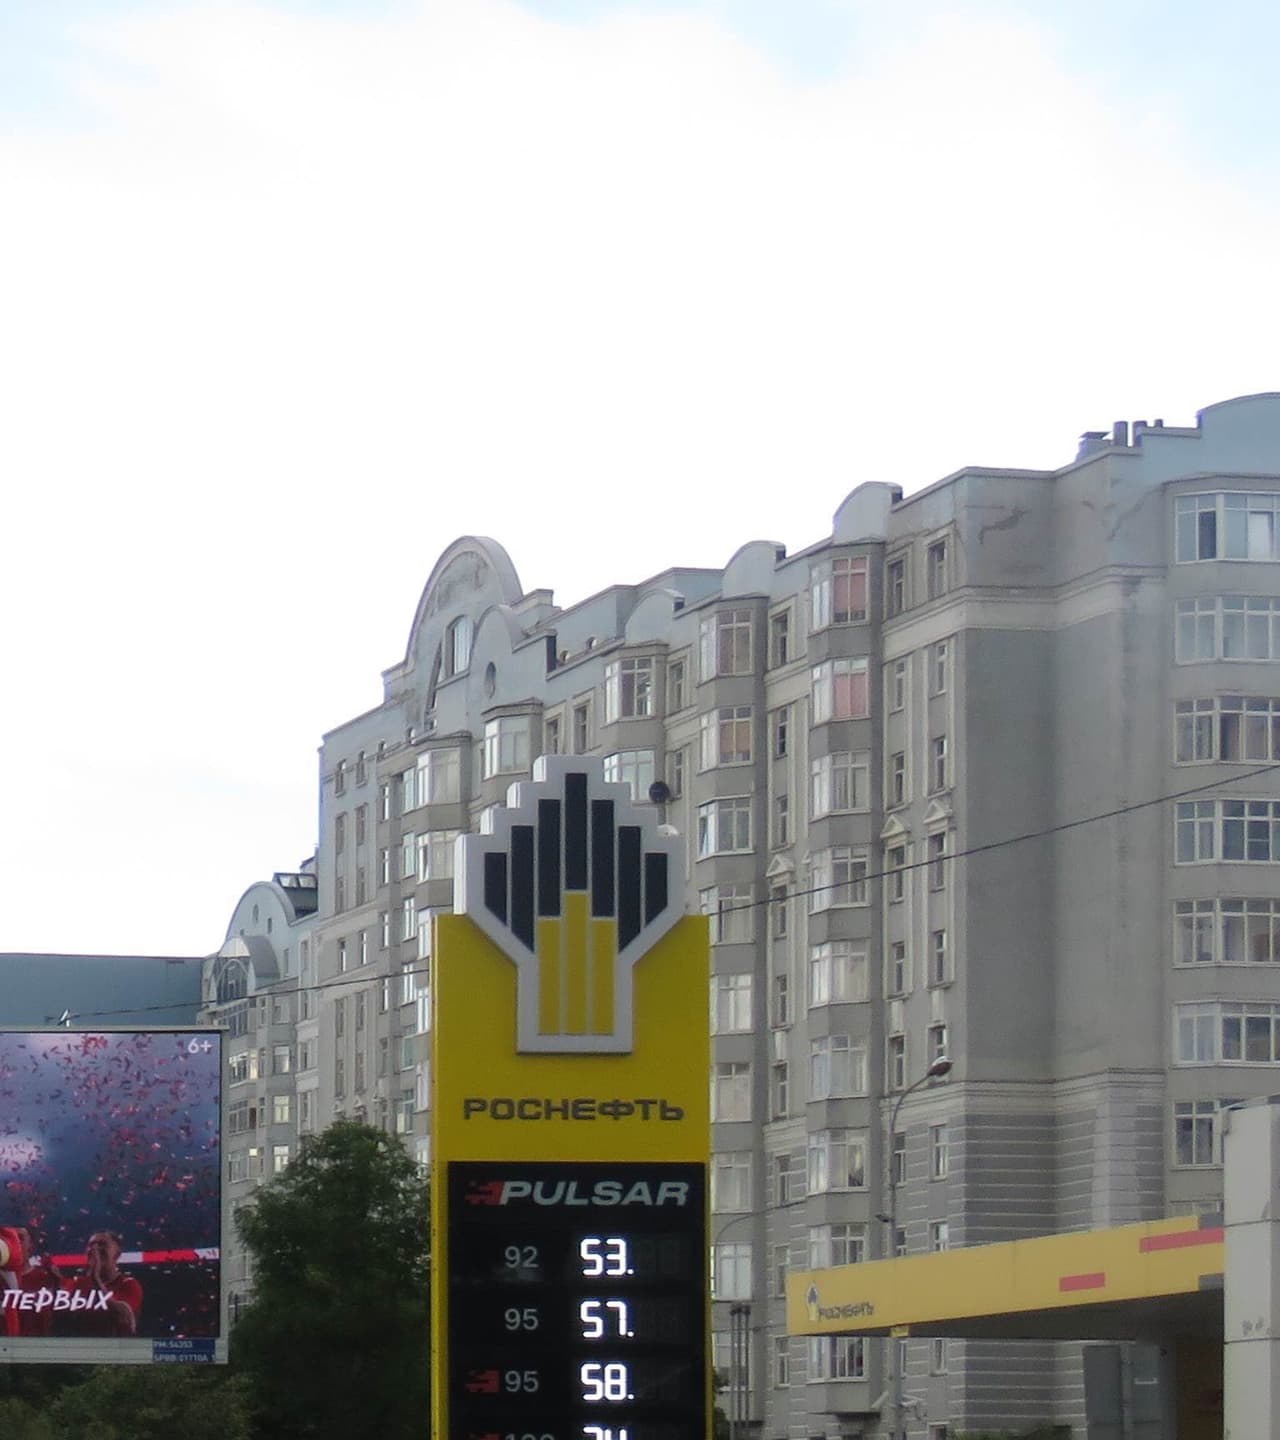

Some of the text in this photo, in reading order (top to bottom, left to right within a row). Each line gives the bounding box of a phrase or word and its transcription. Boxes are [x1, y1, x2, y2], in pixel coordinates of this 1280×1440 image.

[188, 1037, 212, 1054] 6+
[463, 1097, 685, 1122] РОСНЕФТЬ
[500, 1180, 690, 1206] PULSAR
[504, 1246, 539, 1269] 92
[504, 1308, 539, 1331] 95
[504, 1370, 539, 1393] 95
